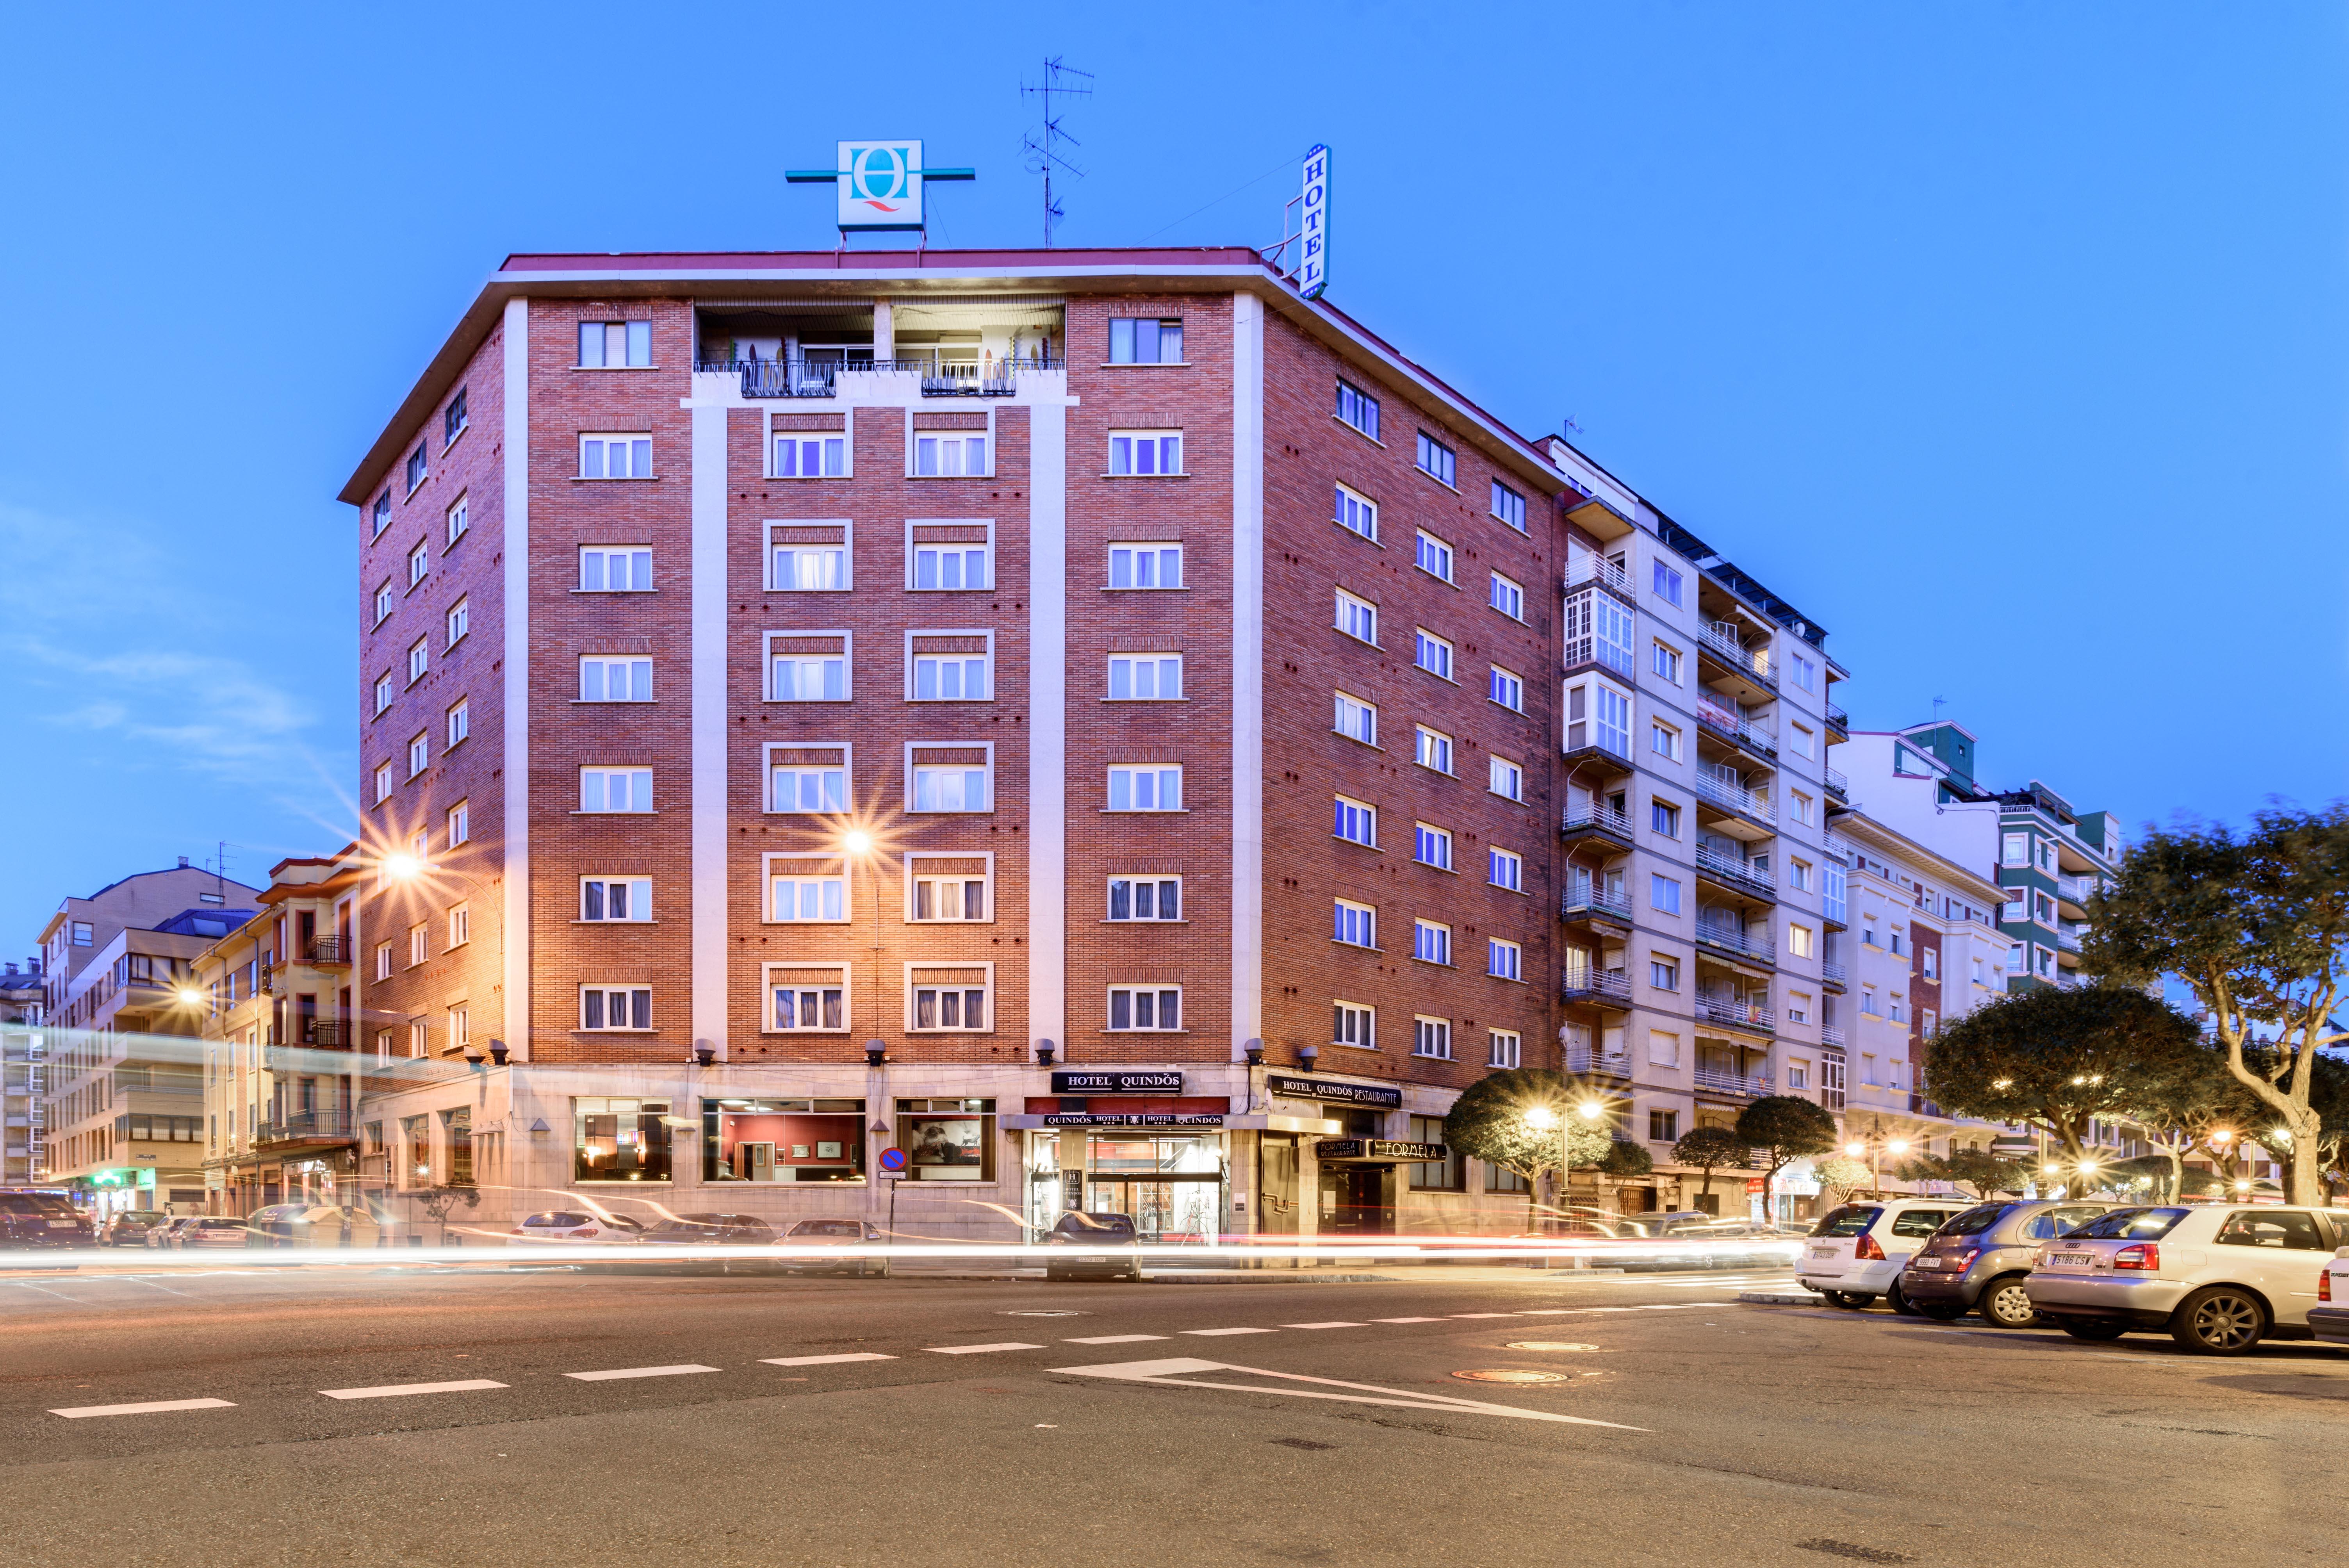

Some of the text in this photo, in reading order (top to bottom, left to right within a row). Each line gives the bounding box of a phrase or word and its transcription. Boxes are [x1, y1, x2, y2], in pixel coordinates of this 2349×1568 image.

[1305, 157, 1324, 283] HOTEL
[1068, 1074, 1179, 1087] HOTEL QUINDÓS
[1283, 1081, 1397, 1104] HOTEL QUINDÓS RESTAURANTE
[1048, 1115, 1091, 1124] QUINDÓS
[1321, 1142, 1355, 1151] FORMELA
[1386, 1142, 1436, 1158] FORMELA
[2056, 1255, 2091, 1265] 5186 CSW
